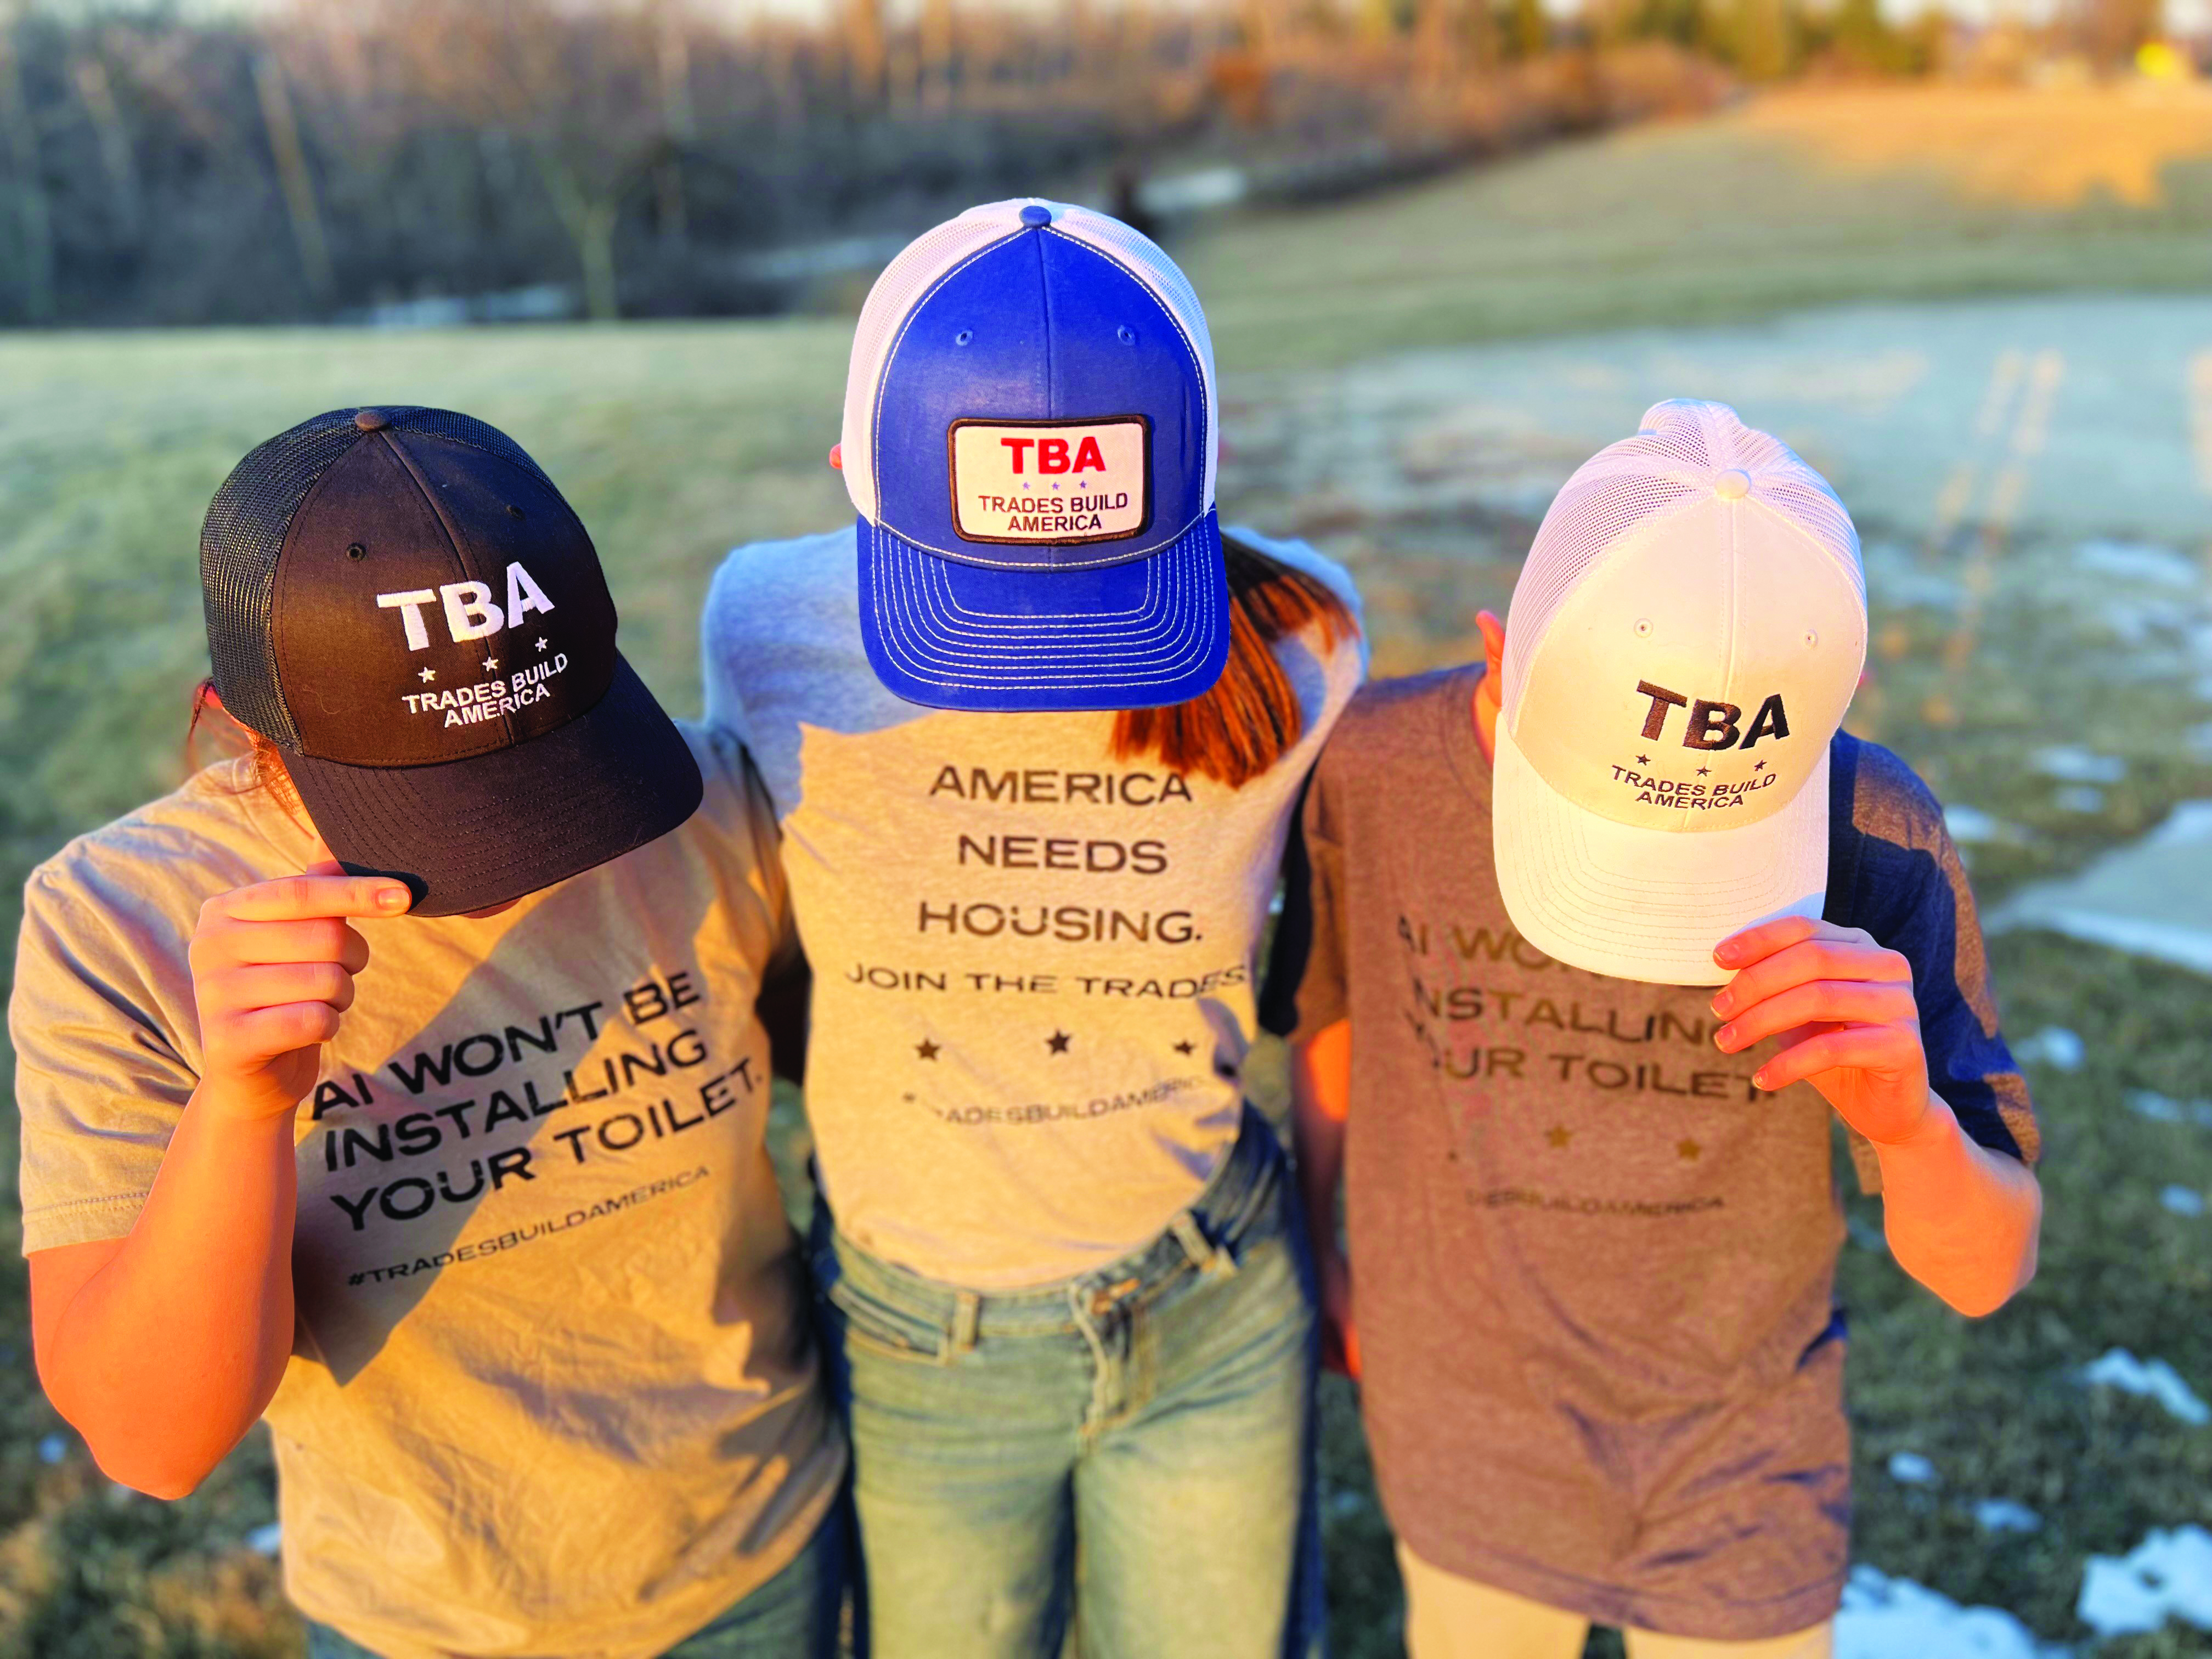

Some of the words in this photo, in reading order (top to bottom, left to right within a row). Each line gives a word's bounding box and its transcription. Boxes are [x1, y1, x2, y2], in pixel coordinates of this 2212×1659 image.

[1001, 437, 1105, 474] TBA
[979, 495, 1063, 514] TRADES
[1070, 493, 1128, 511] BUILD
[1008, 514, 1102, 532] AMERICA
[377, 561, 555, 651] TBA
[402, 680, 506, 714] TRADES
[511, 653, 568, 692] BUILD
[444, 683, 550, 728] AMERICA
[1637, 679, 1790, 751] TBA
[930, 765, 1193, 806] AMERICA
[1611, 764, 1706, 796] TRADES
[1712, 773, 1776, 796] BUILD
[1635, 791, 1743, 810] AMERICA
[958, 834, 1168, 874] NEEDS
[918, 900, 1203, 944] HOUSING.
[845, 963, 946, 991] JOIN
[965, 973, 1058, 994] THE
[1075, 964, 1246, 999] TRADES
[312, 1073, 374, 1120] AI
[388, 1001, 604, 1094] WON'T
[623, 971, 701, 1025] BE
[324, 1029, 709, 1172] INSTALLING
[330, 1146, 536, 1231] YOUR
[553, 1056, 764, 1164] TOILET.
[347, 1166, 710, 1286] #TRADESBUILDAMERICA
